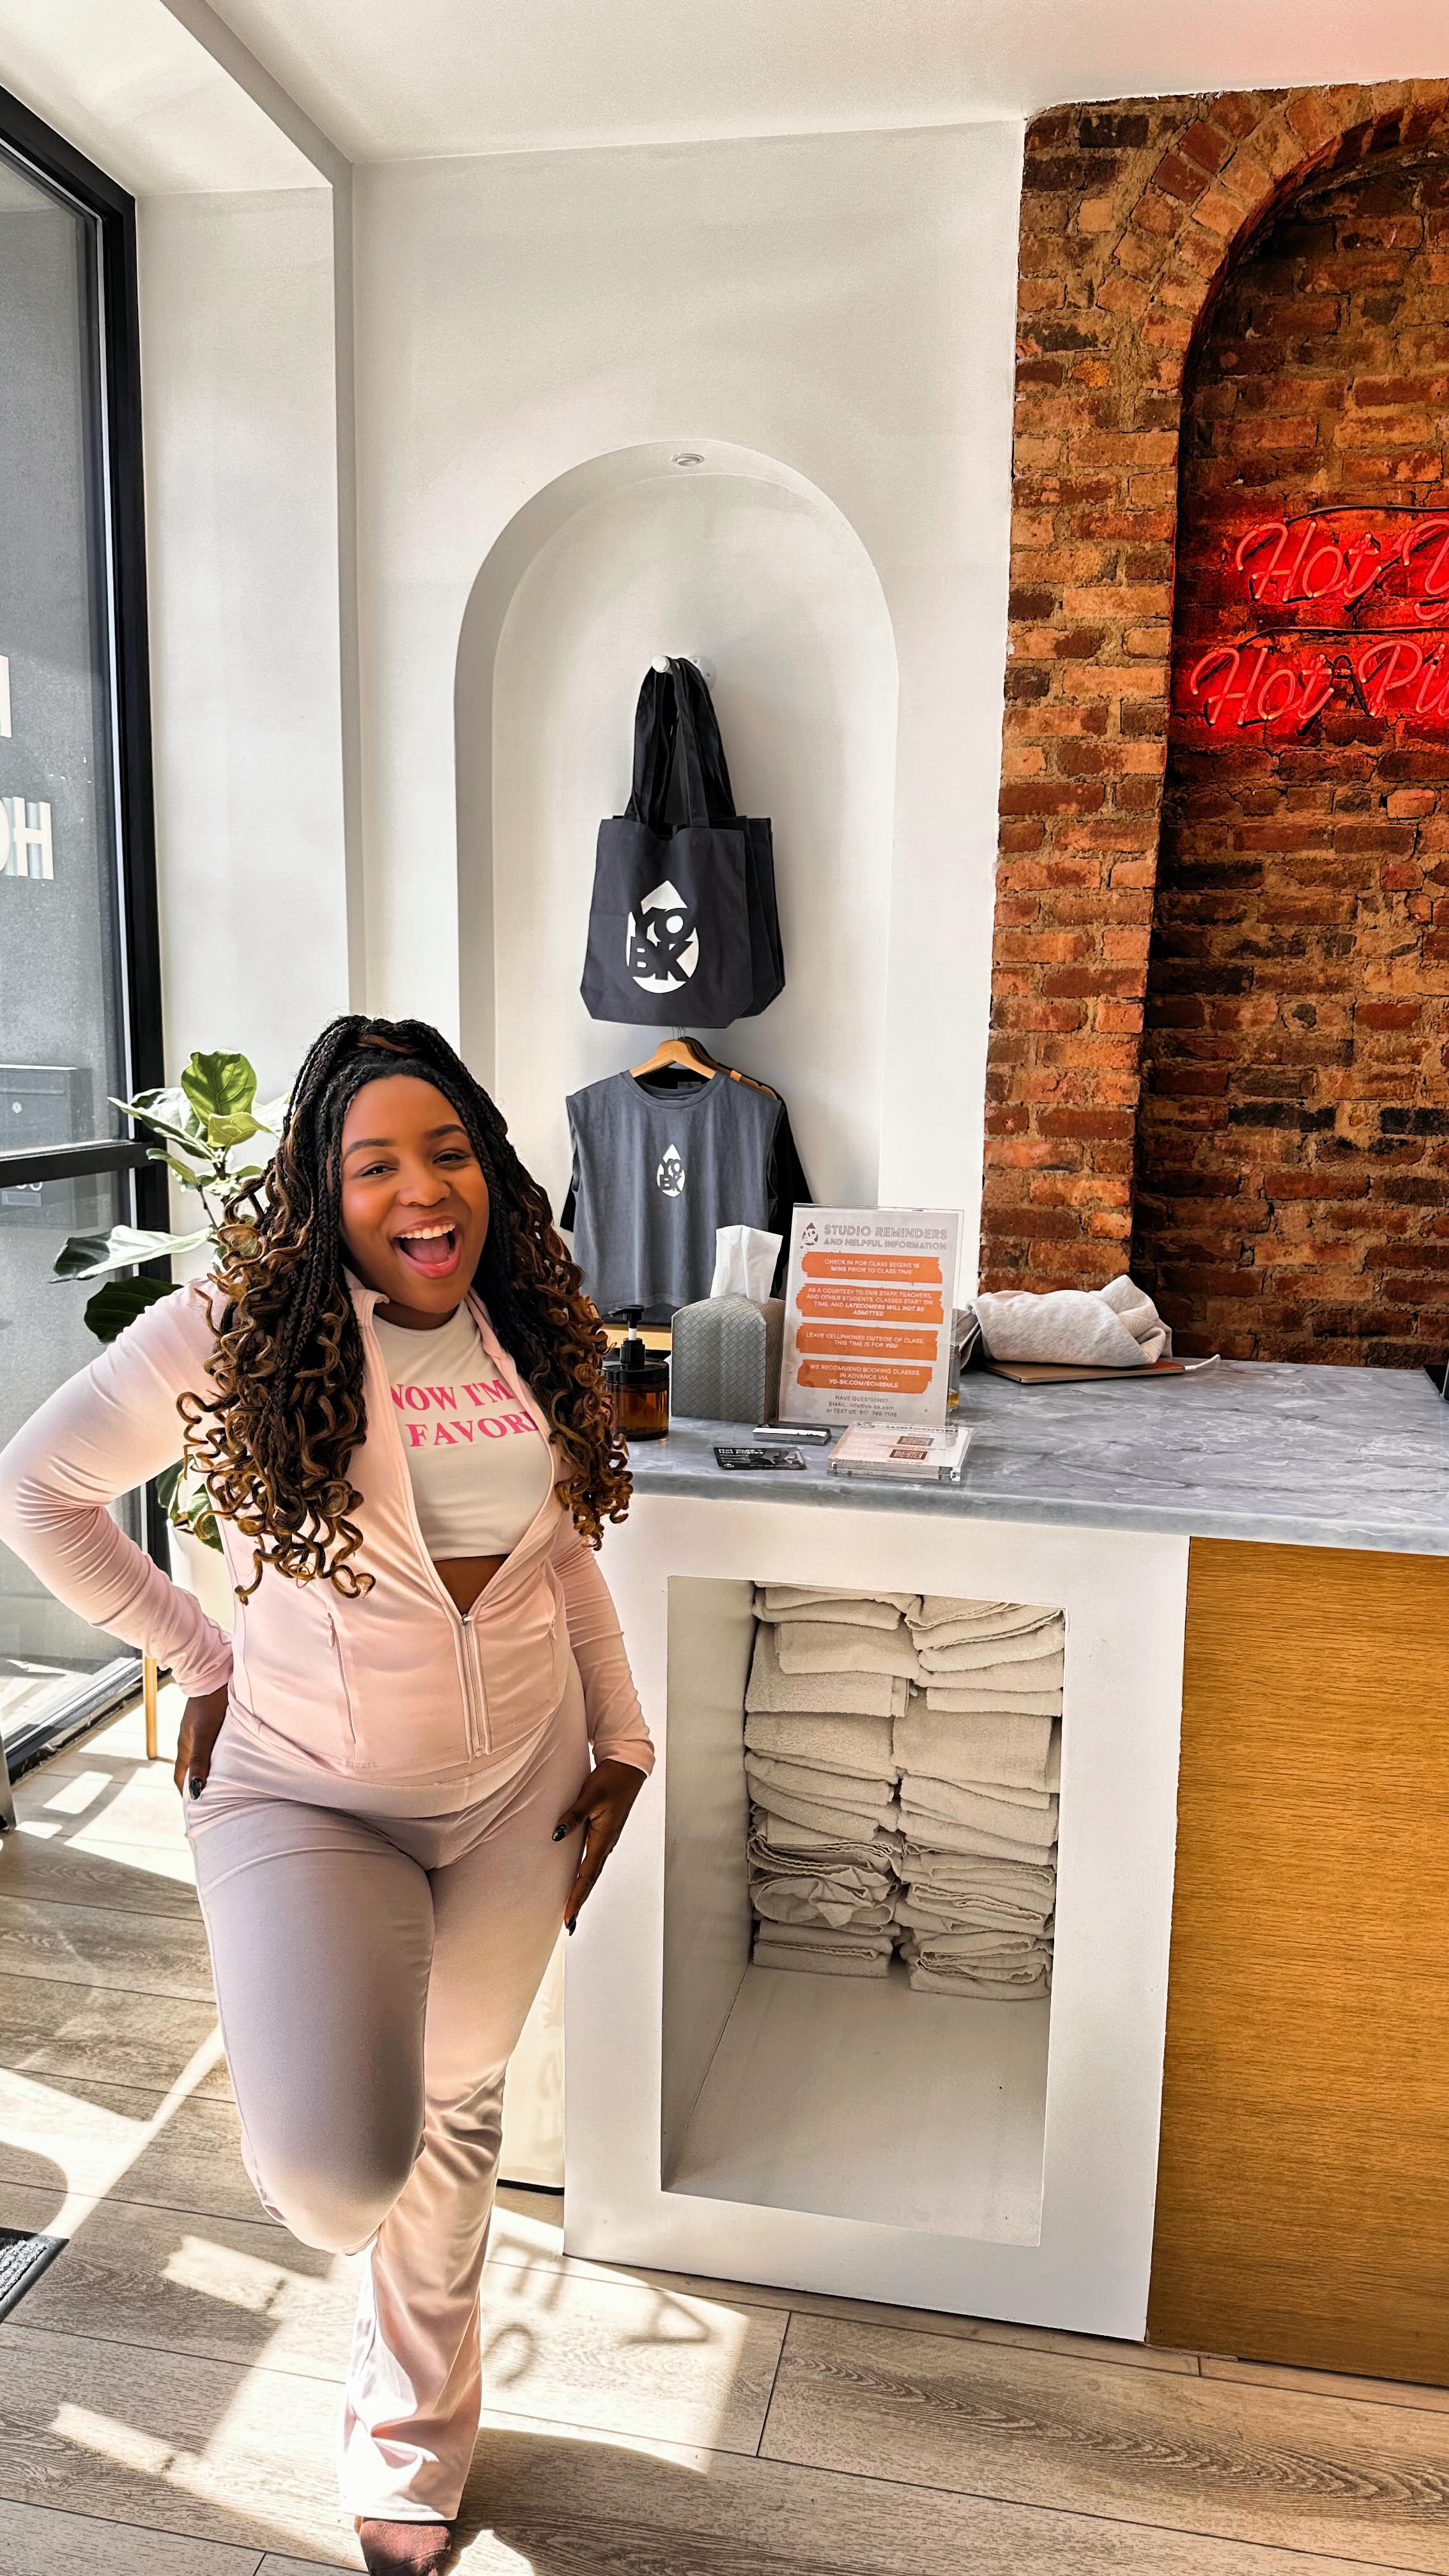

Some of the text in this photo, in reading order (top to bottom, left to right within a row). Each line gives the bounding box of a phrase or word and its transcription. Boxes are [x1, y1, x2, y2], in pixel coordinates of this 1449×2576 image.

[1236, 521, 1381, 602] Hot
[1190, 647, 1335, 725] Hot
[824, 1224, 947, 1239] STUDIO REMINDERS
[824, 1237, 843, 1245] AND
[845, 1238, 882, 1247] HELPFUL
[885, 1240, 947, 1250] INFORMATION
[825, 1333, 865, 1341] CELLPHONES
[821, 1364, 861, 1372] RECOMMEND
[461, 1379, 516, 1407] I'M
